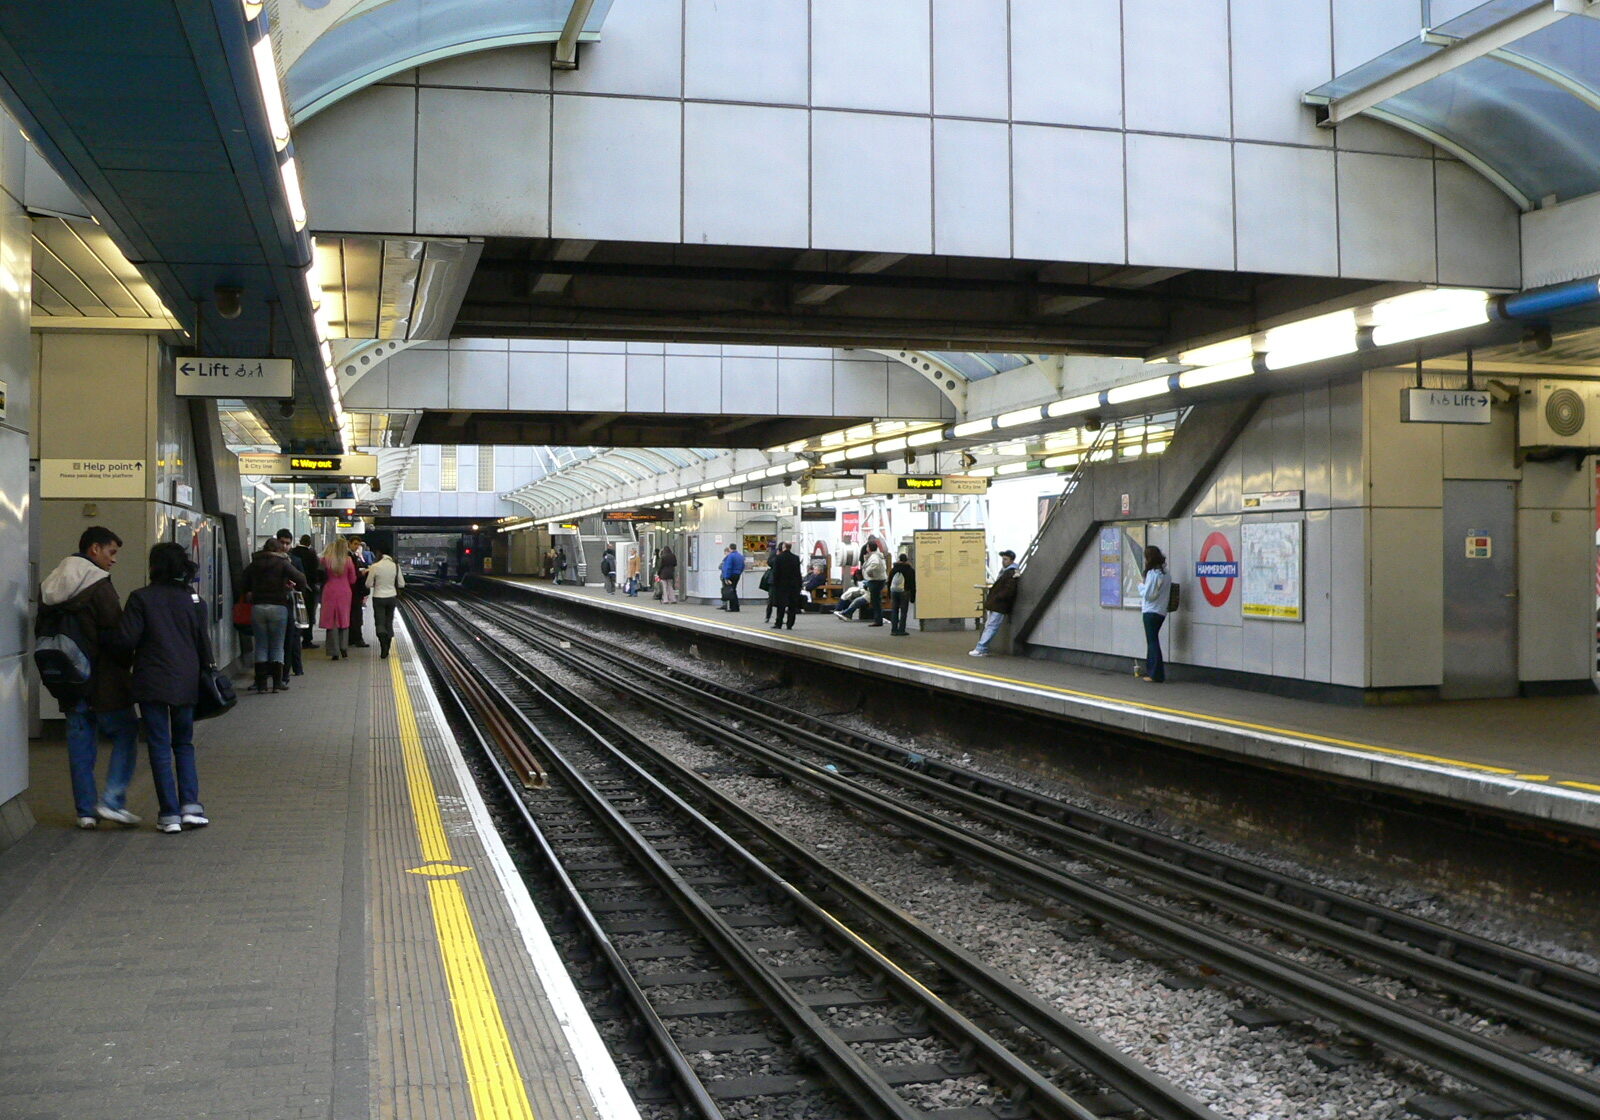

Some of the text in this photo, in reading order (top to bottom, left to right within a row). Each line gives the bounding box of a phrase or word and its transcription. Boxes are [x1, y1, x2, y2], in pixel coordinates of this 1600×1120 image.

[199, 362, 229, 377] Lift
[1454, 394, 1475, 407] Lift
[83, 463, 134, 472] Help point
[300, 459, 332, 469] Way out
[906, 479, 921, 489] Way
[1197, 564, 1237, 575] HAMMERSMITH
